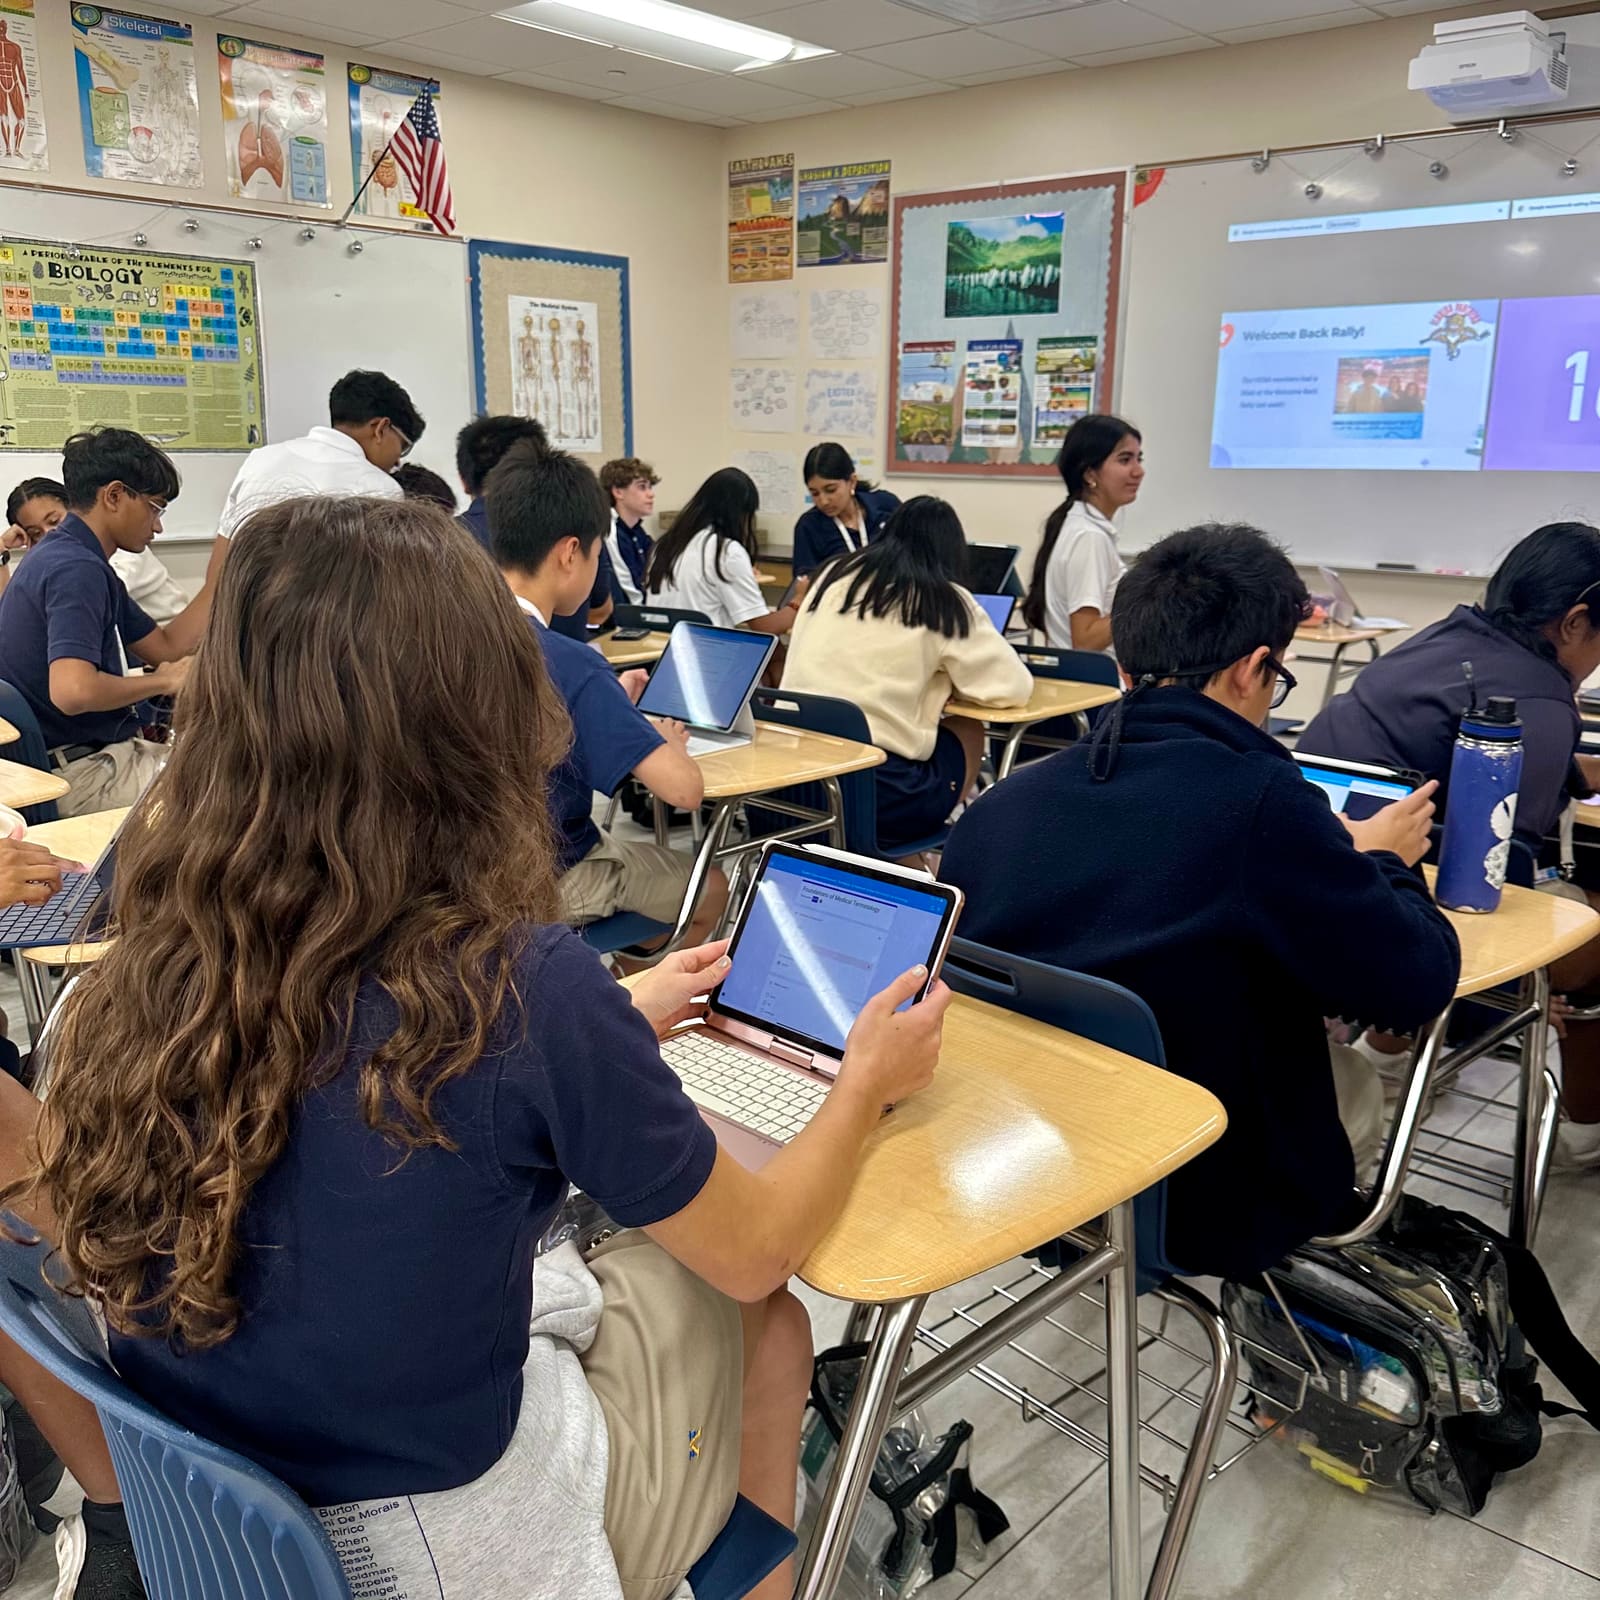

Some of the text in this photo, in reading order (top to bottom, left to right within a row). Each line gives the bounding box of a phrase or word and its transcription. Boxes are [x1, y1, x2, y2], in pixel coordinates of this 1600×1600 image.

[108, 16, 163, 35] Skeletal
[22, 249, 28, 257] A
[31, 250, 66, 260] PERIO
[79, 255, 108, 263] TABLE
[145, 261, 193, 272] ELEMENTS
[196, 265, 212, 273] FOR
[48, 261, 143, 285] BIOLOGY
[1242, 326, 1365, 341] Welcome Back Rally!
[1565, 350, 1600, 422] 1
[319, 1503, 360, 1518] Burton
[337, 1516, 355, 1525] De
[359, 1501, 399, 1519] Morais
[332, 1536, 368, 1548] Cohen
[347, 1566, 395, 1581] oldman
[353, 1583, 397, 1599] Kenigel
